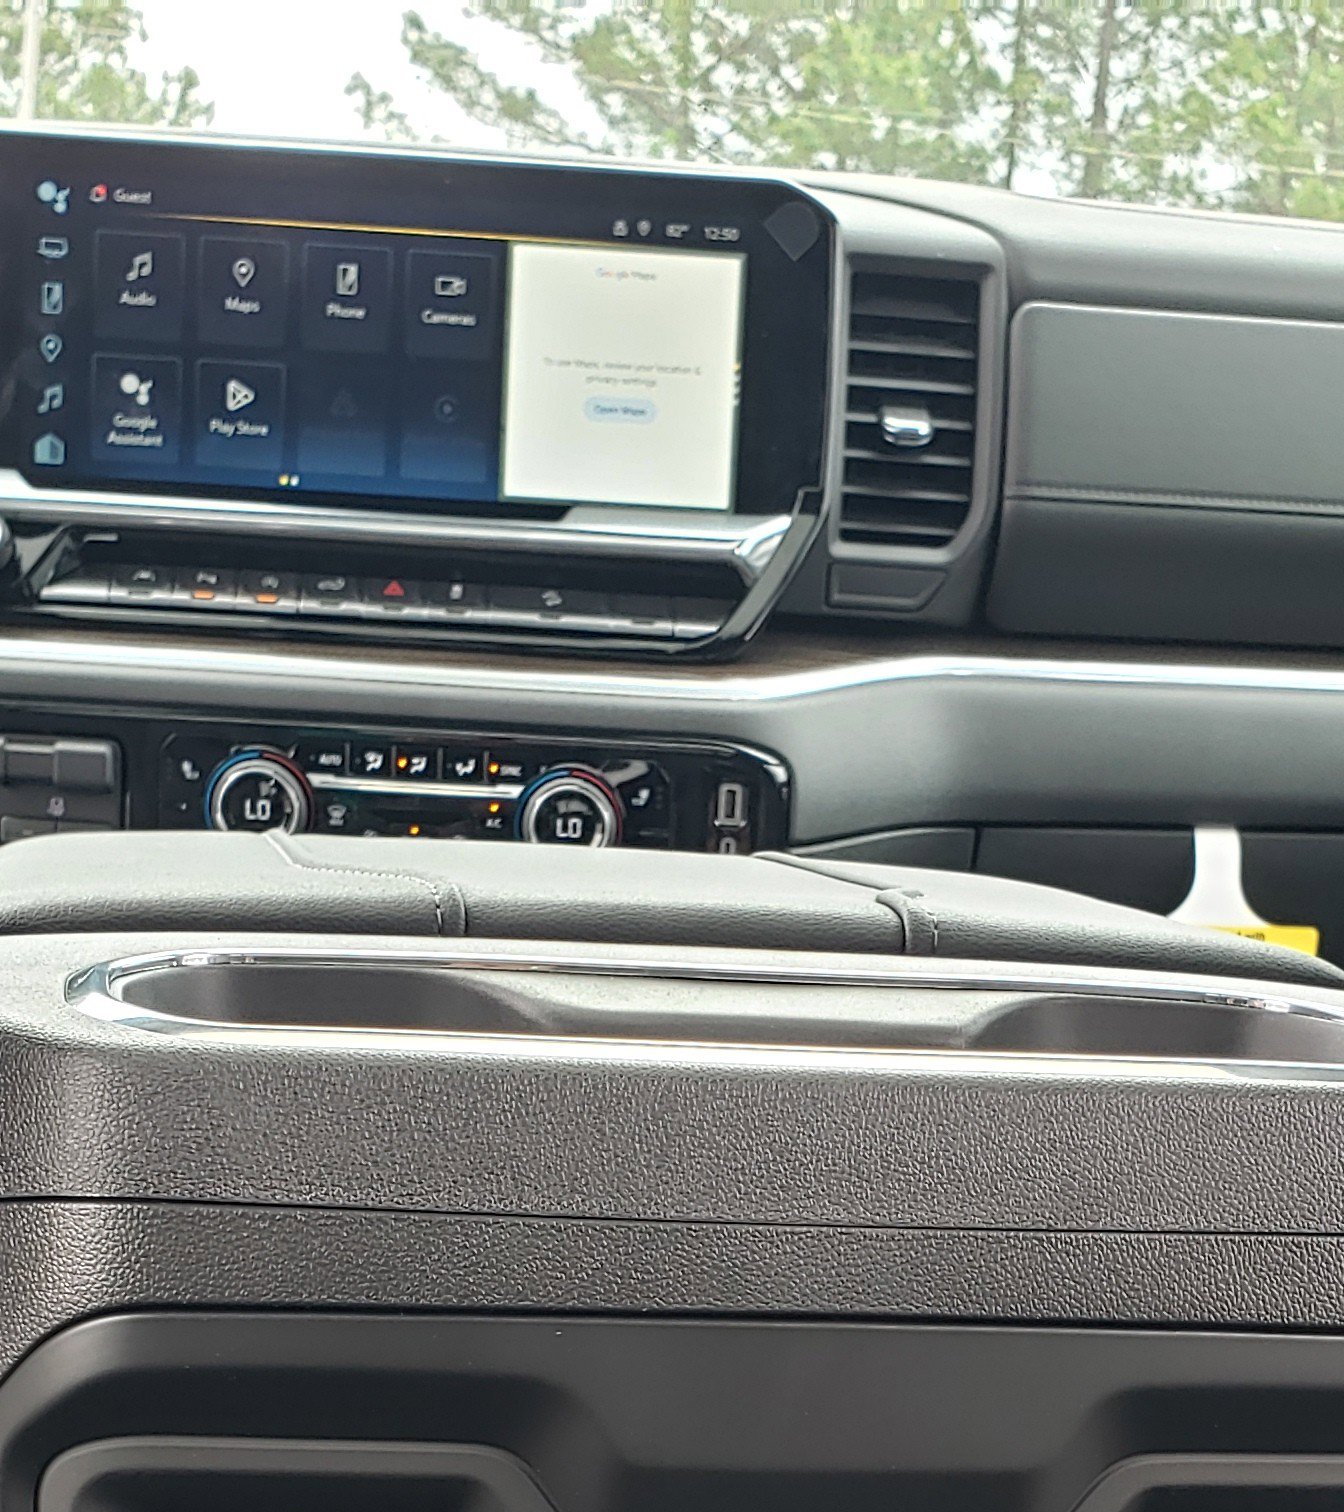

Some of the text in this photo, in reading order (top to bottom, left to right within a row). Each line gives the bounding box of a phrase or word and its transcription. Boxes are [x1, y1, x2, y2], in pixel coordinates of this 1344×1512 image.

[113, 187, 153, 205] Guest
[119, 289, 157, 306] Audio
[224, 296, 261, 315] Maps
[325, 303, 367, 320] Phone
[421, 308, 478, 327] Cameras
[112, 412, 158, 432] Google
[209, 418, 270, 437] Play Store
[106, 430, 164, 448] Assistant
[318, 752, 343, 767] AUTO
[244, 798, 272, 822] LO
[556, 816, 584, 840] LO
